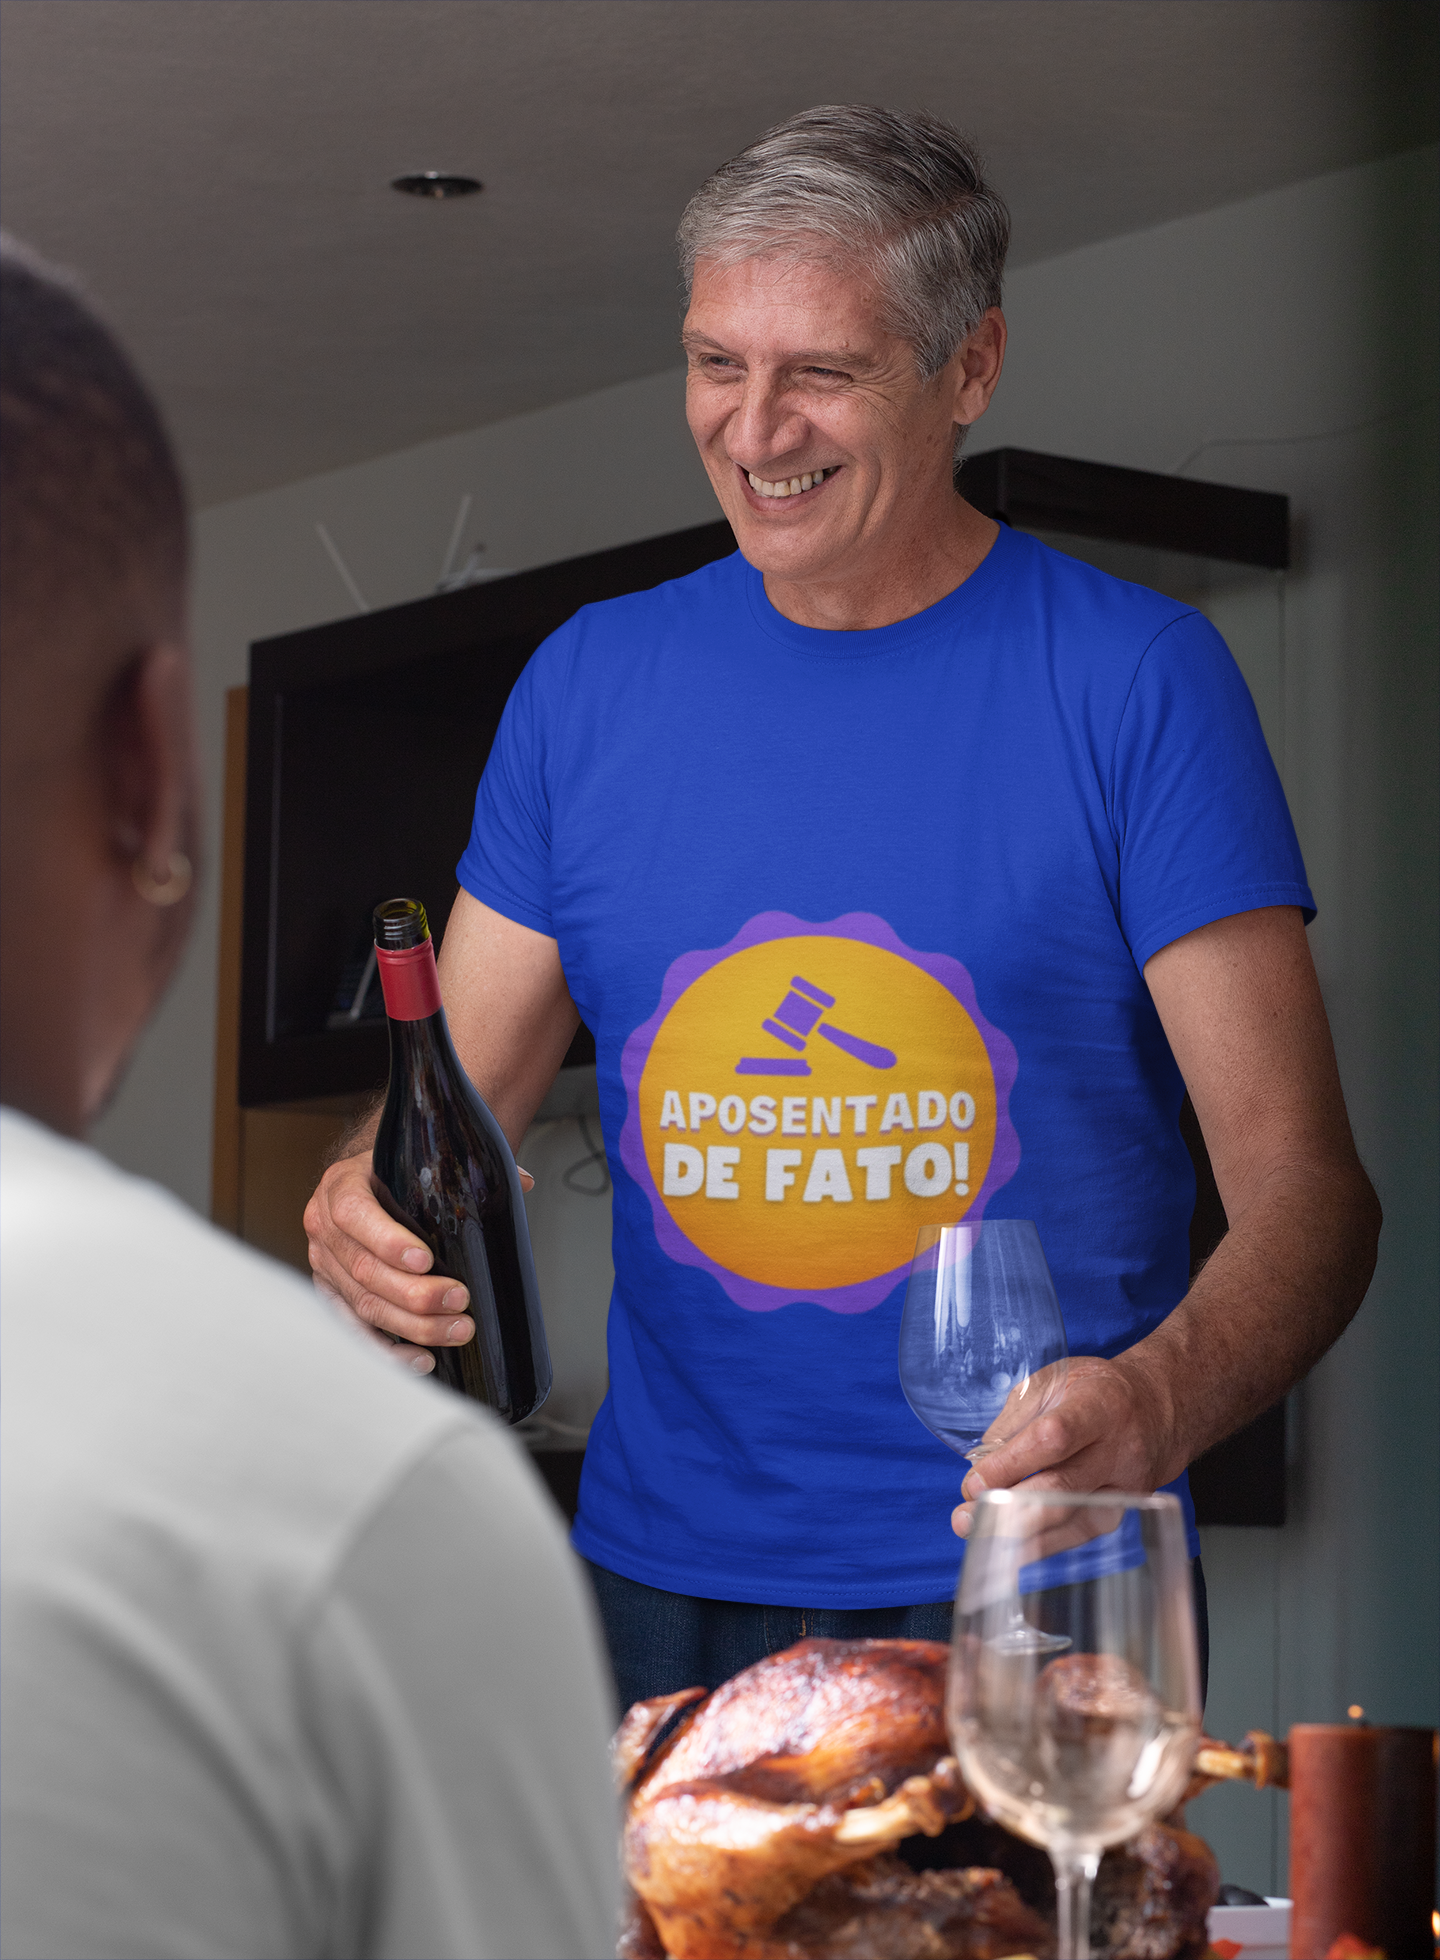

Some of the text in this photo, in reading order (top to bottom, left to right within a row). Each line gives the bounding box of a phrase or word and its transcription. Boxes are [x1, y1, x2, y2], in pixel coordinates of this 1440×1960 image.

[659, 1090, 976, 1137] APOSENTADO
[662, 1142, 970, 1202] DE FATO!
